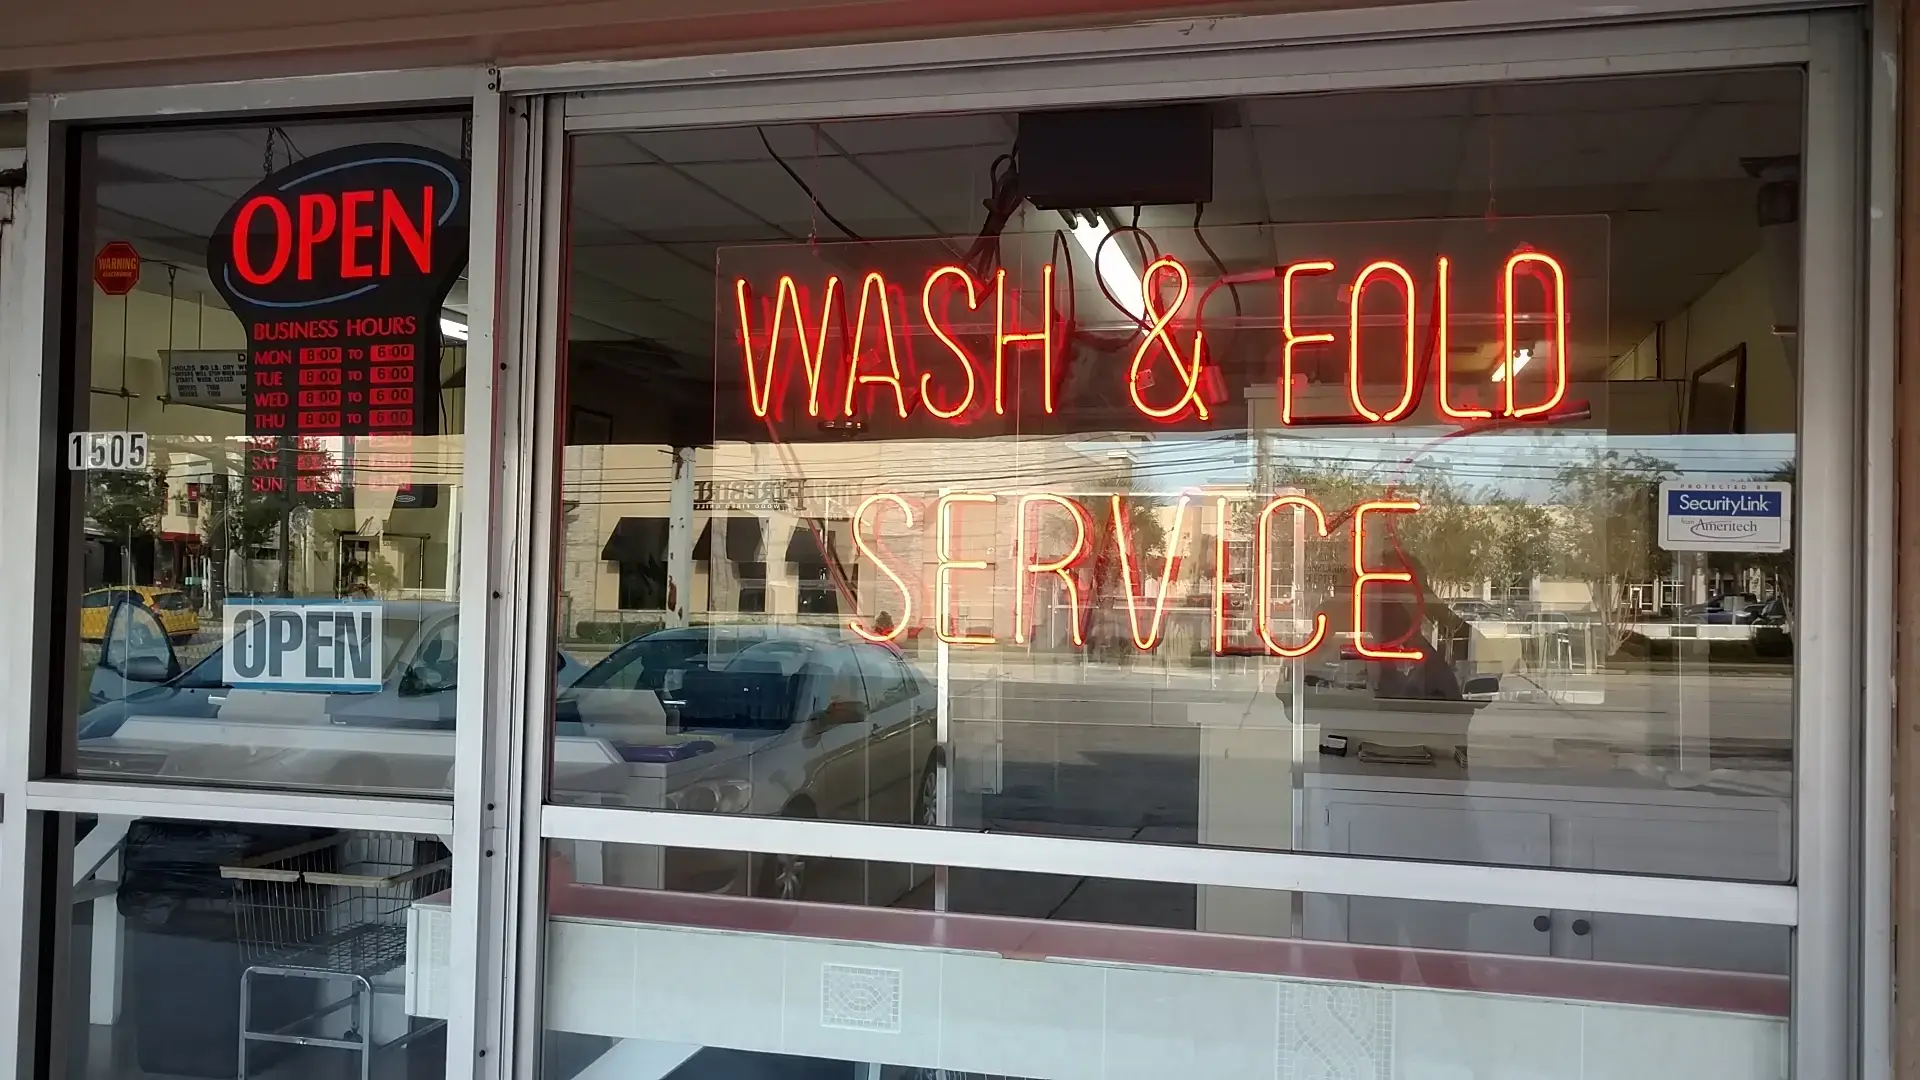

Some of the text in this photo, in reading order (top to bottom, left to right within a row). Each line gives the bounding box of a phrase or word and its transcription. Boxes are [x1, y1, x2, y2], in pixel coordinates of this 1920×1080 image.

[232, 185, 433, 285] OPEN
[99, 257, 137, 270] WARNING
[254, 315, 417, 341] BUSINESS HOURS
[737, 249, 1567, 425] WASH & FOLD
[254, 350, 292, 365] MON
[347, 349, 364, 360] TO
[254, 371, 283, 386] TUE
[347, 370, 363, 381] TO
[253, 391, 289, 407] WED
[347, 392, 363, 403] TO
[254, 413, 286, 428] THU
[347, 413, 362, 424] TO
[72, 434, 144, 467] 1505
[252, 456, 278, 471] SAT
[251, 477, 284, 492] SUN
[1679, 494, 1769, 515] SecurityLink
[1695, 518, 1758, 532] Ameritech
[849, 492, 1425, 660] SERVICE
[233, 609, 372, 679] OPEN
